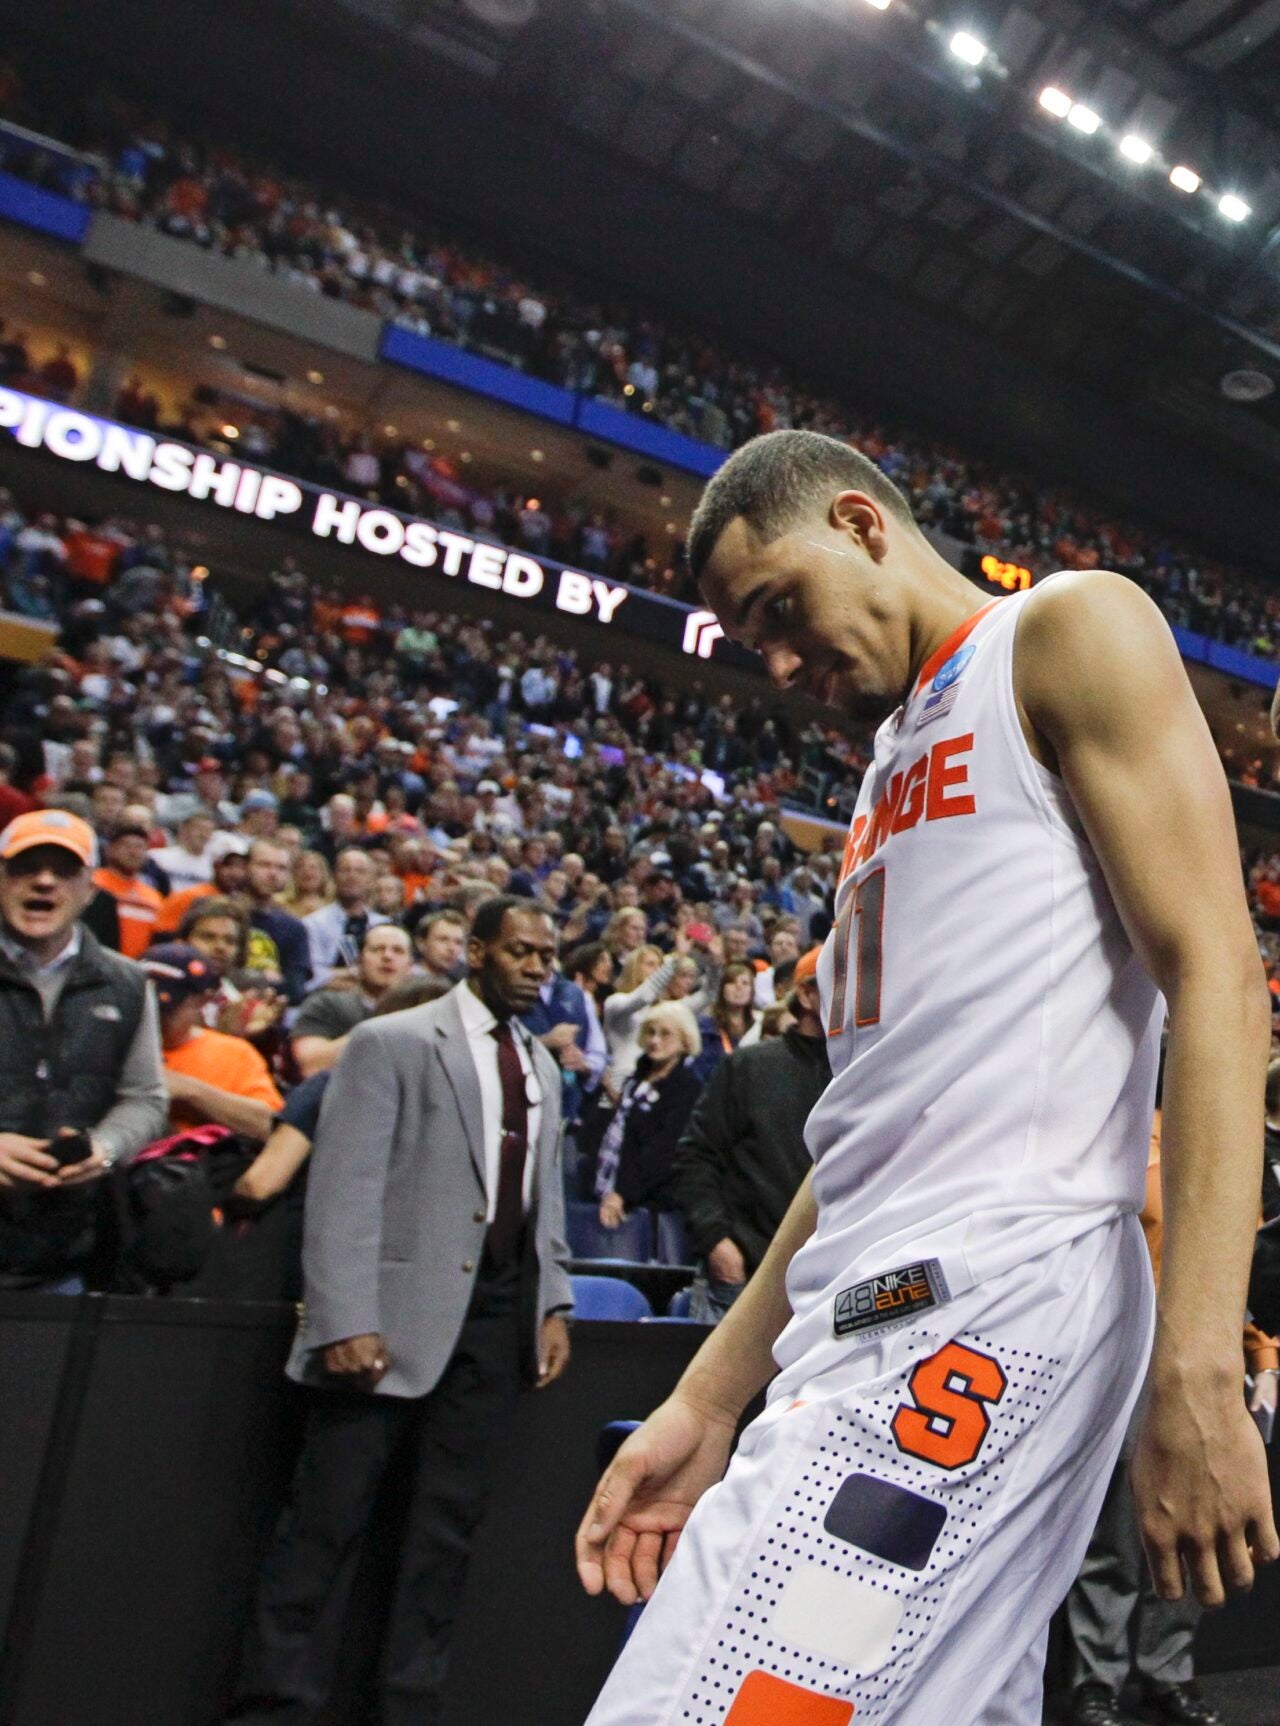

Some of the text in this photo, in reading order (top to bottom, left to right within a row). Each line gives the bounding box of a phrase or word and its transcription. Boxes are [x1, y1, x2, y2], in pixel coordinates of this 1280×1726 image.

[312, 493, 544, 598] HOSTED
[555, 570, 628, 623] BY
[837, 732, 976, 886] RANGE
[829, 866, 885, 1036] 11
[838, 1284, 874, 1317] 48
[873, 1266, 924, 1295] NIKE
[875, 1281, 931, 1311] ELITE
[890, 1339, 1008, 1471] S
